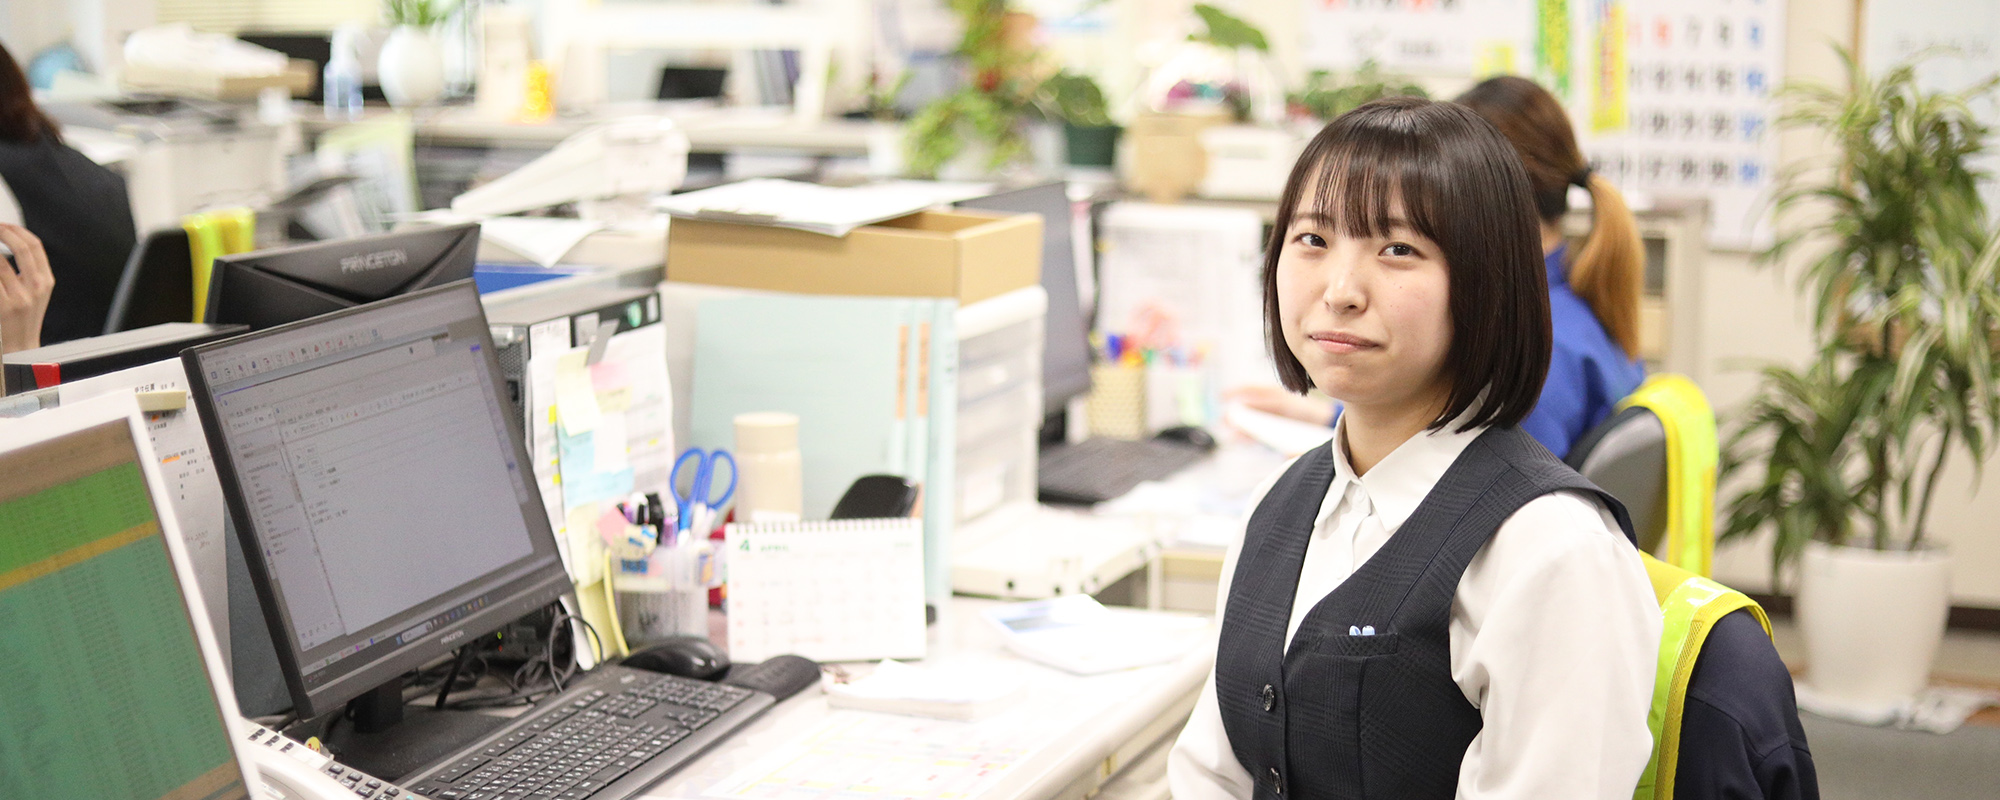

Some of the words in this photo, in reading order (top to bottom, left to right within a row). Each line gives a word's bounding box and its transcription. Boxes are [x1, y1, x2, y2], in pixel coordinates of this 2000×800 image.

[340, 249, 407, 273] PRINCETON
[739, 539, 750, 551] 4
[440, 630, 464, 645] PRINCETON
